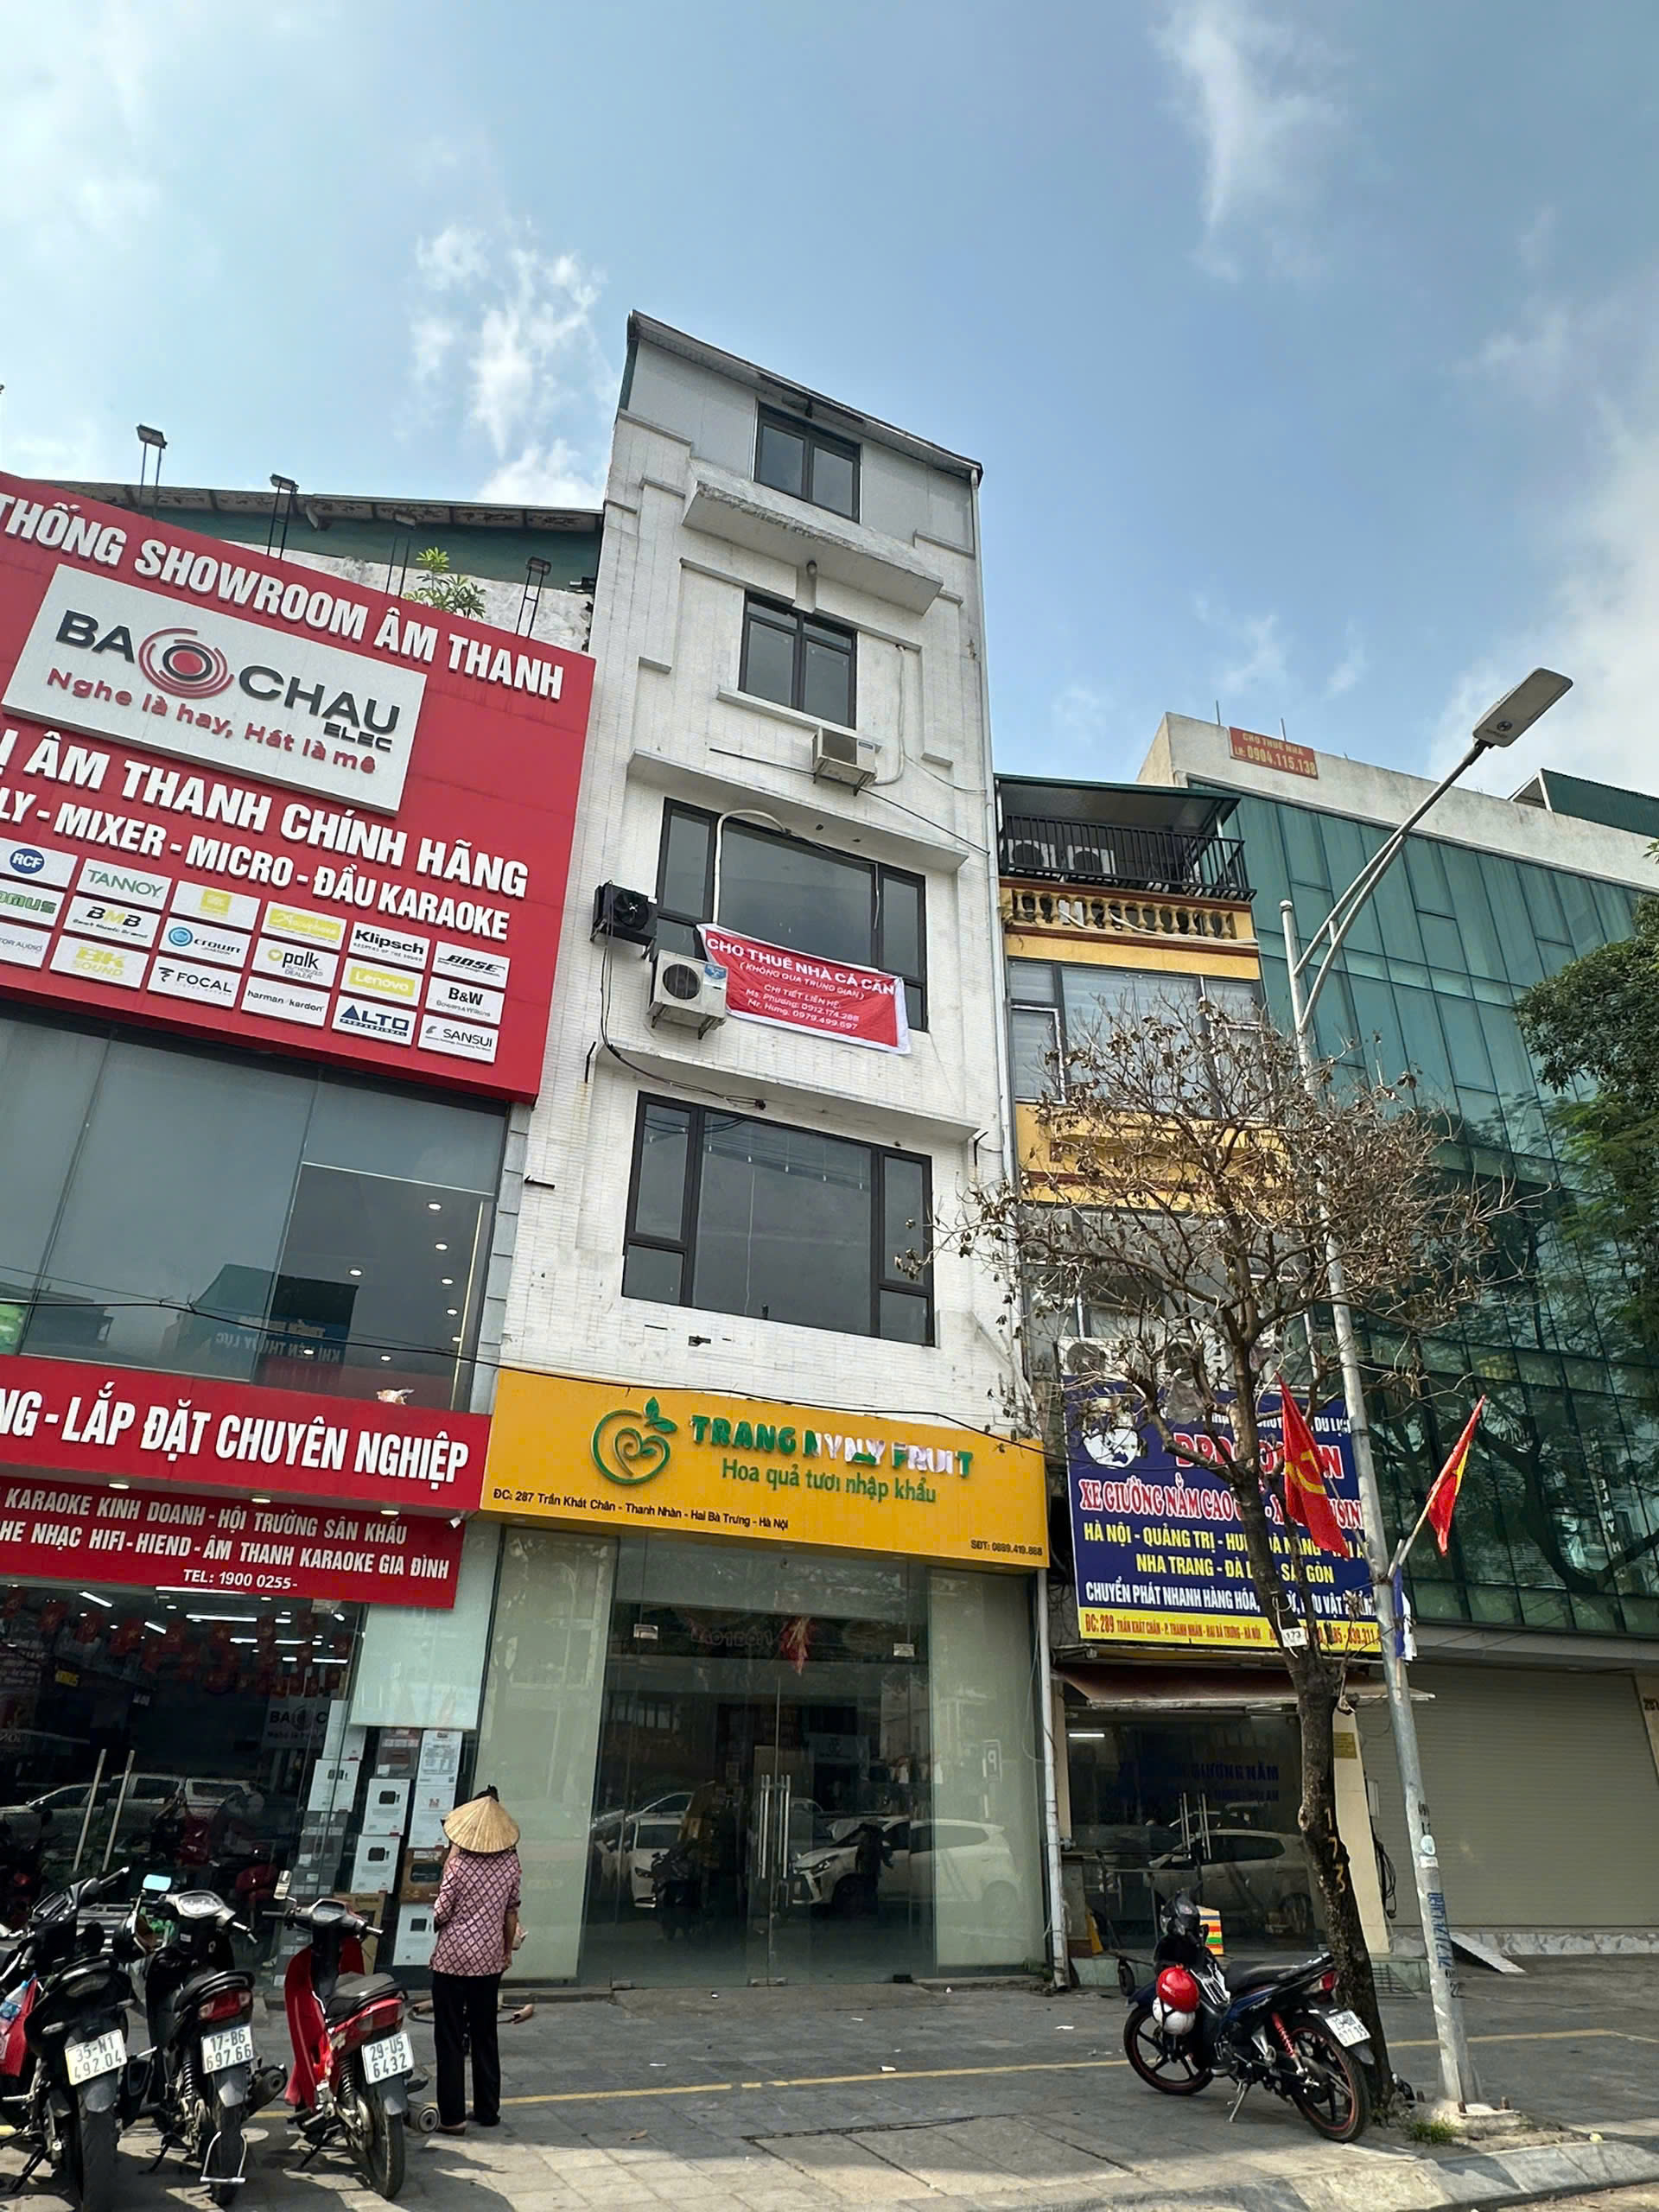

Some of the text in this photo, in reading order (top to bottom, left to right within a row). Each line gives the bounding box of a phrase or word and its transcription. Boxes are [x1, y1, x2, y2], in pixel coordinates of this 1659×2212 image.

[135, 537, 370, 642] SHOWROOM
[373, 607, 434, 664] ÂM
[447, 632, 565, 702] THANH
[238, 664, 399, 734] CHAU
[46, 667, 377, 775] Nghe là hay, Hát là mê
[323, 721, 393, 752] ELEC
[23, 730, 529, 899] ÂM THANH CHÍNH HÃNG
[12, 852, 42, 868] RCF
[54, 802, 167, 858] MIXER
[187, 837, 294, 889] MICRO
[314, 863, 376, 910] ĐẦU
[378, 885, 510, 941] KARAOKE
[88, 868, 163, 897] TANNOY
[86, 906, 142, 927] BMB
[354, 930, 423, 954] Klipsch
[282, 951, 320, 969] polk
[437, 954, 505, 973] BOSE
[707, 938, 745, 957] CHO
[747, 947, 793, 970] THUÊ
[796, 962, 832, 982] NHÀ
[835, 972, 858, 987] CẢ
[861, 978, 895, 995] CĂN
[176, 972, 232, 993] FOCAL
[356, 971, 409, 991] Lenovo
[782, 972, 802, 983] QUA
[804, 976, 835, 992] TRUNG
[247, 990, 283, 1004] harman
[448, 987, 483, 1005] B&W
[764, 984, 782, 995] CHI
[783, 986, 804, 1000] TIẾT
[804, 992, 825, 1005] LIÊN
[443, 1028, 493, 1047] SANSUI
[61, 1381, 136, 1446] LẮP
[140, 1398, 211, 1464] ĐẶT
[214, 1413, 348, 1471] CHUYÊN
[353, 1431, 469, 1491] NGHIỆP
[1315, 1416, 1330, 1433] DU
[690, 1414, 796, 1455] TRANG
[891, 1441, 973, 1479] FRUIT
[721, 1458, 937, 1503] Hoa quả tươi nhập khẩu
[515, 1491, 534, 1502] 287
[537, 1492, 561, 1506] Trần
[563, 1496, 587, 1509] Khát
[590, 1499, 615, 1511] Chân
[625, 1503, 655, 1516] Thanh
[657, 1506, 682, 1518] Nhàn
[691, 1510, 706, 1521] Hai
[708, 1510, 721, 1522] Bà
[723, 1513, 751, 1528] Trưng
[759, 1516, 771, 1528] Hà
[773, 1518, 789, 1531] Nội
[1079, 1479, 1103, 1510] XE
[1103, 1475, 1165, 1516] GIƯỜNG
[1201, 1487, 1234, 1521] CAO
[4, 1488, 407, 1545] KARAOKE KINH DOANH HỘI TRƯỜNG SÂN KHẤU
[1084, 1520, 1216, 1553] HÀ NỘI QUẢNG TRỊ
[30, 1522, 83, 1551] NHẠC
[88, 1529, 126, 1551] HIFI
[135, 1532, 192, 1557] HIEND
[202, 1535, 232, 1560] ÂM
[239, 1541, 295, 1566] THANH
[299, 1548, 375, 1573] KARAOKE
[378, 1554, 404, 1575] GIA
[410, 1554, 449, 1580] ĐÌNH
[183, 1568, 214, 1583] TEL:
[219, 1571, 253, 1586] 1900
[1136, 1554, 1166, 1573] NHA
[1168, 1555, 1214, 1577] TRANG
[1224, 1556, 1249, 1579] ĐÀ
[1306, 1561, 1335, 1584] GÒN
[1085, 1576, 1135, 1604] CHUYỂN
[1132, 1582, 1161, 1605] PHÁT
[1163, 1586, 1203, 1609] NHANH
[1204, 1586, 1234, 1610] HÀNG
[1323, 1593, 1342, 1618] VẬT
[1100, 1614, 1114, 1632] 289
[1286, 1631, 1302, 1640] 173
[211, 2029, 245, 2052] 17-B6
[370, 2036, 404, 2062] 29-U5
[207, 2044, 251, 2070] 697.66
[373, 2053, 407, 2078] 6432
